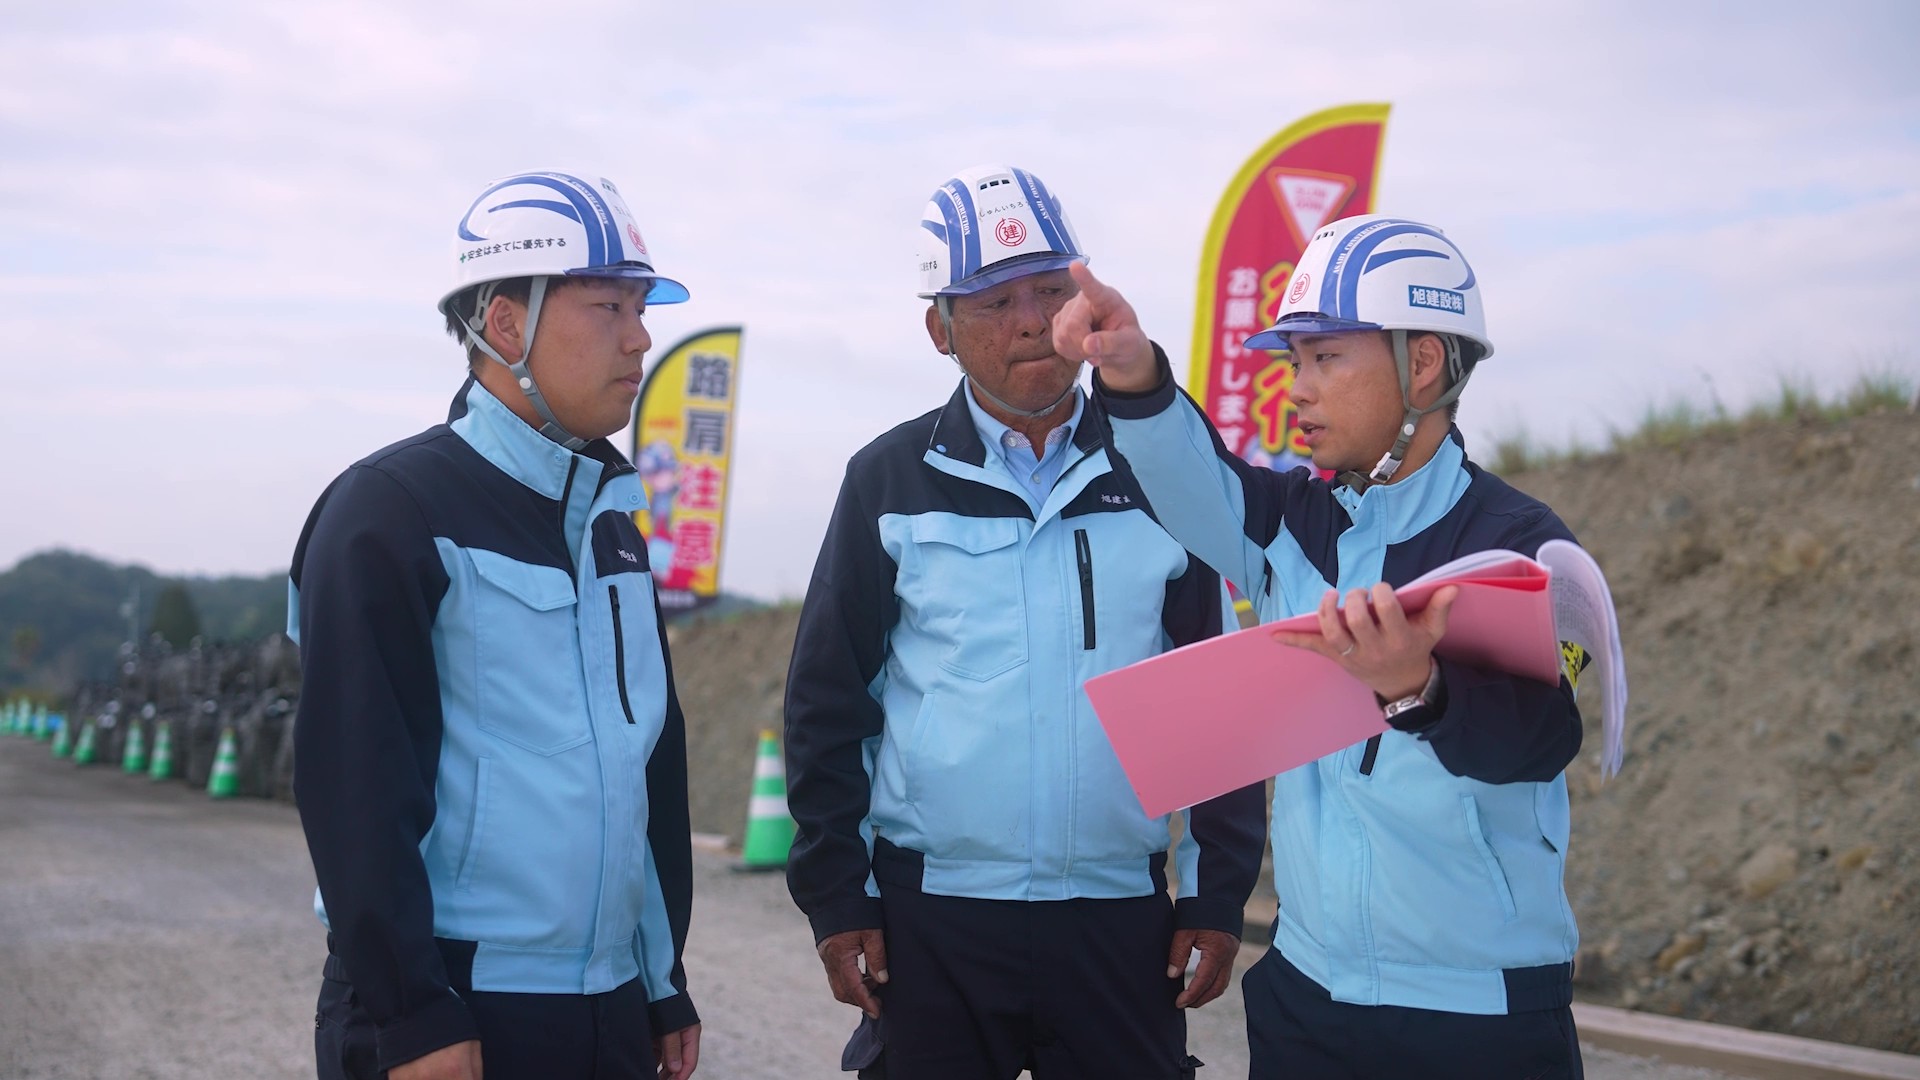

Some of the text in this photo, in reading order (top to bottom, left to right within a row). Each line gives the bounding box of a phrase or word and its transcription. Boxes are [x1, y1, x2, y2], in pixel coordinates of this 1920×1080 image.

[467, 237, 567, 261] 安全は全てに優先する
[1332, 253, 1346, 275] ASAHI
[674, 353, 732, 566] 路肩注意
